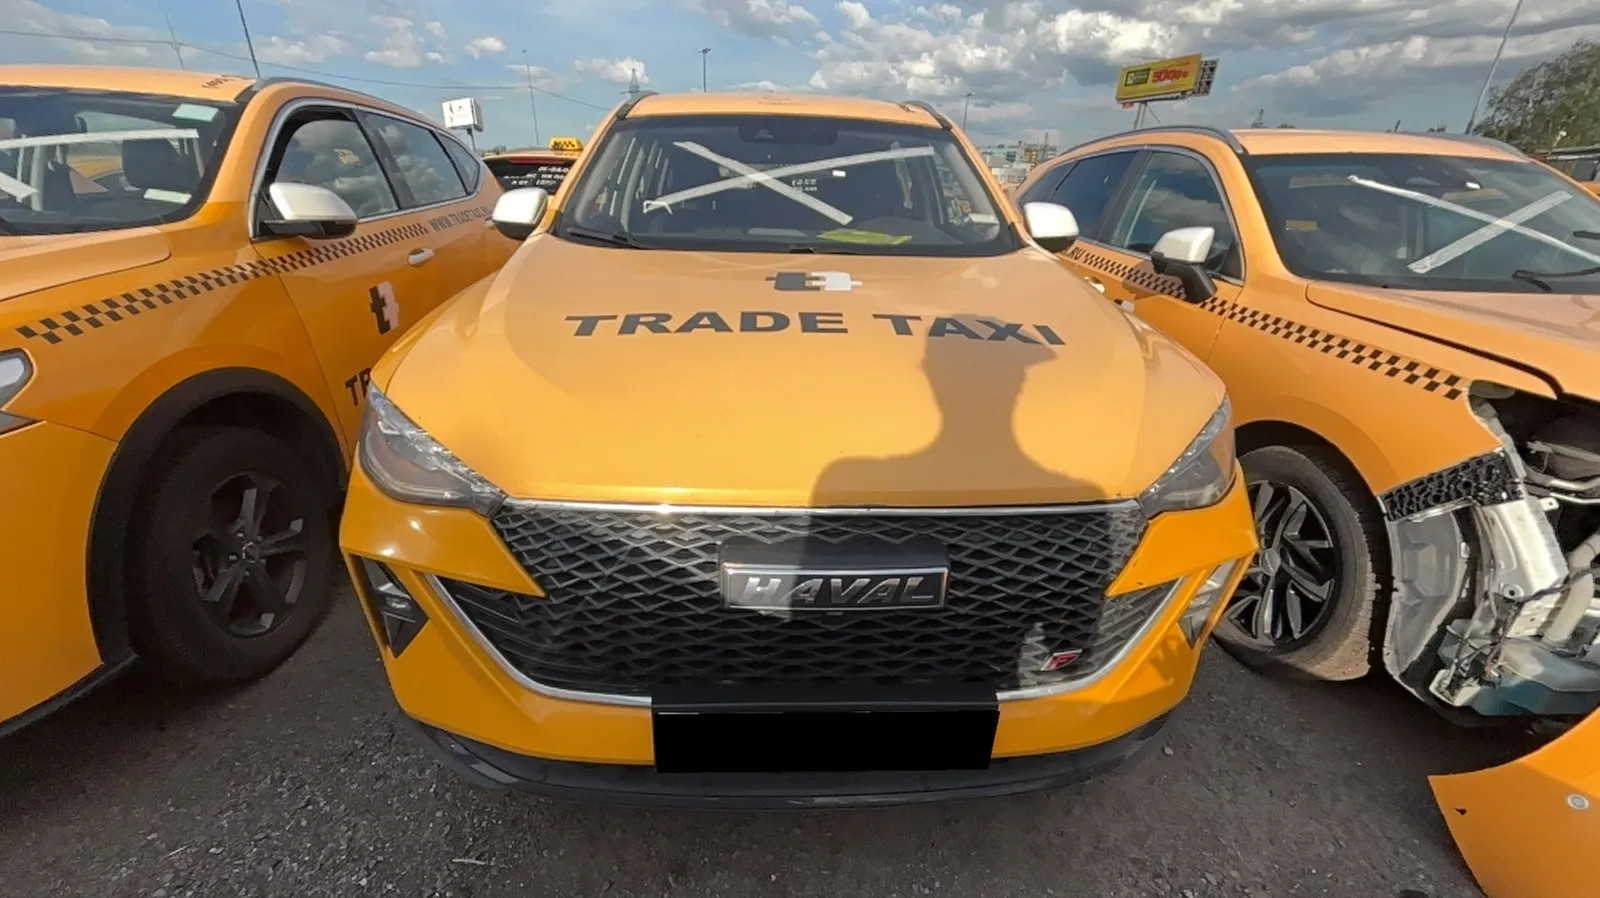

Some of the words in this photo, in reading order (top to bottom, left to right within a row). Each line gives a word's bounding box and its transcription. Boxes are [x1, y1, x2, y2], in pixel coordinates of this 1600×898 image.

[564, 311, 849, 336] TRADE
[871, 313, 1067, 346] TAXI
[740, 576, 934, 605] HAVAL
